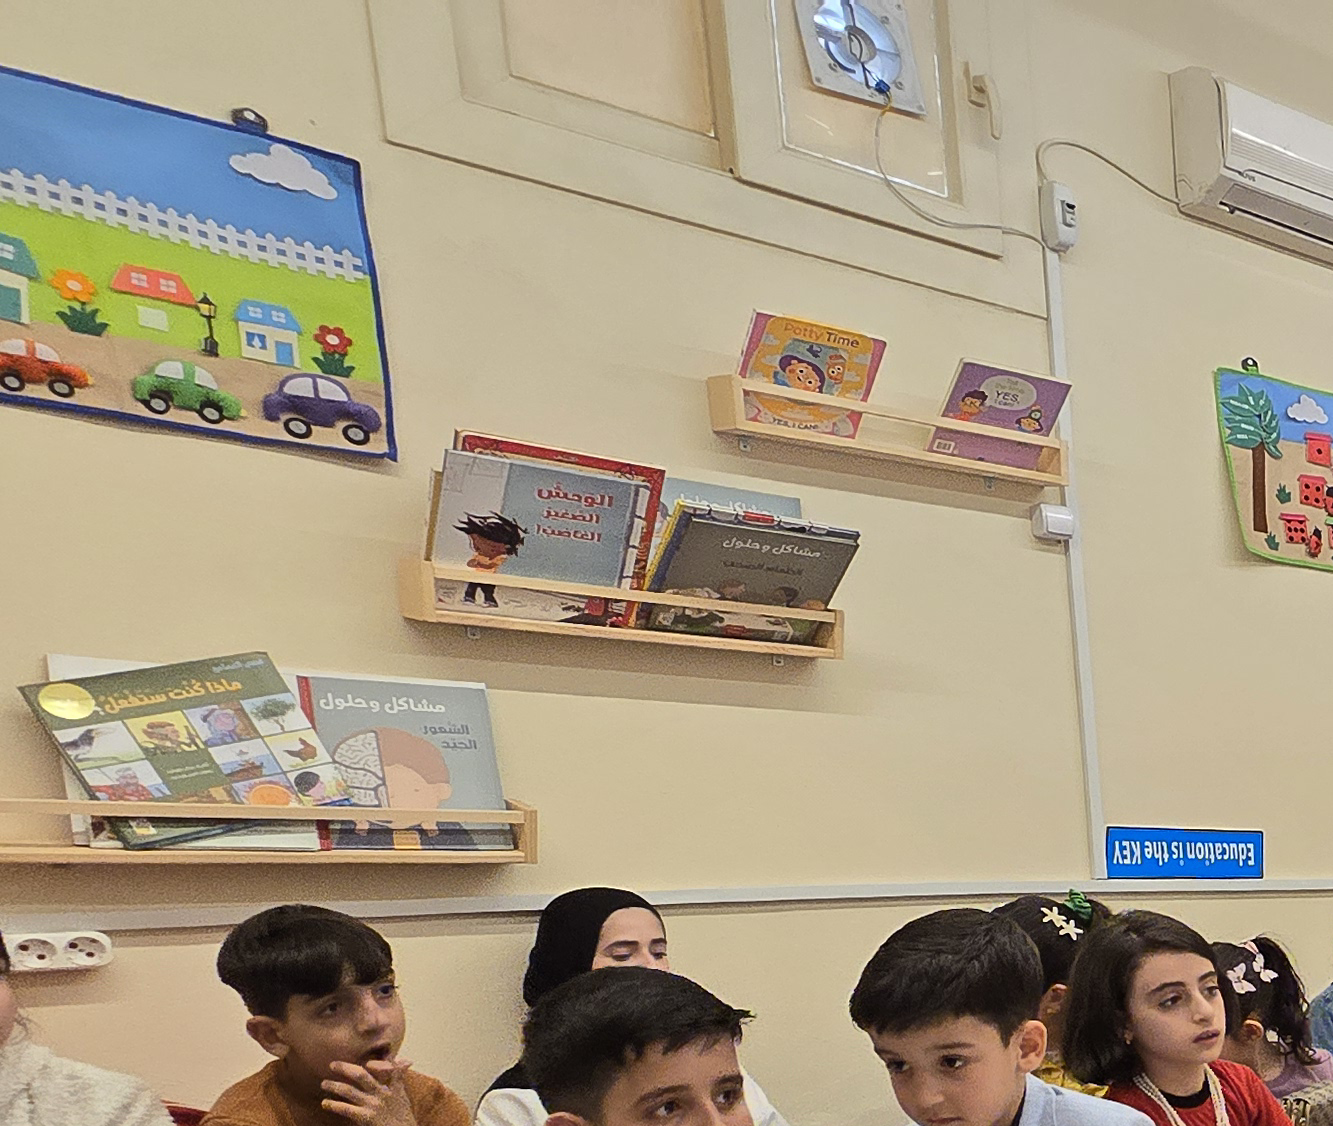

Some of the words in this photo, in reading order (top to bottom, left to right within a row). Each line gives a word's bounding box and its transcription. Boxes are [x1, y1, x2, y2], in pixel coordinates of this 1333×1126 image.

[784, 322, 823, 341] Potty
[826, 331, 860, 348] Time
[772, 544, 820, 557] مشاكل
[206, 679, 242, 694] ماذا
[319, 693, 381, 713] وحلول
[384, 696, 446, 714] مشاكل
[1113, 840, 1142, 865] KEY
[1144, 841, 1170, 866] the
[1172, 841, 1185, 867] is
[1186, 842, 1255, 867] Education
